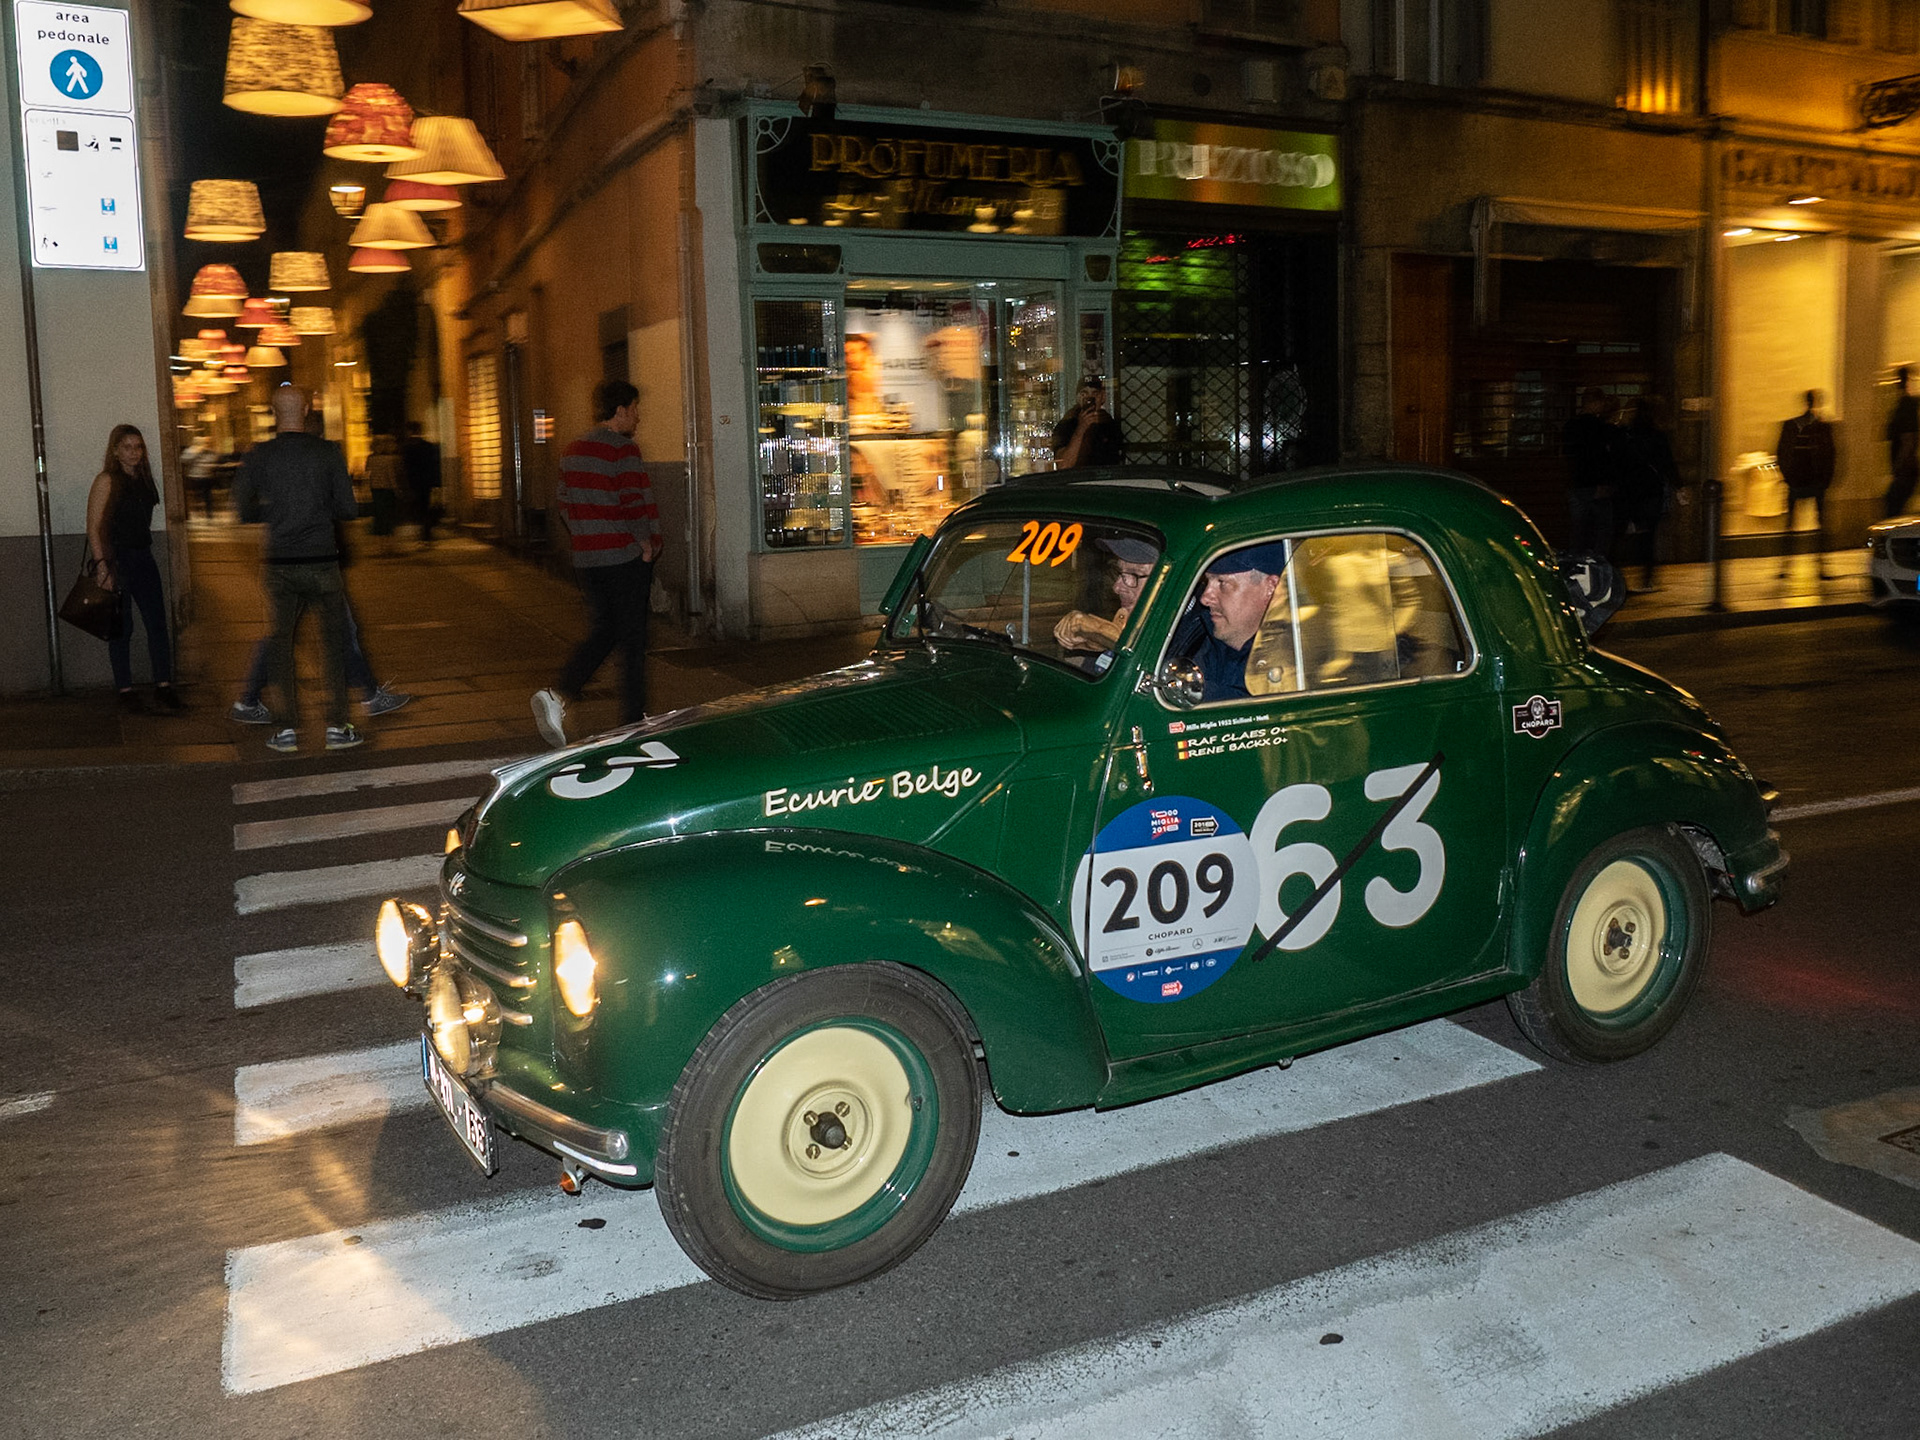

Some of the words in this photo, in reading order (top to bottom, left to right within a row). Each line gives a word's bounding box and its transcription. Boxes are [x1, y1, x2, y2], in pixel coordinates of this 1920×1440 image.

[55, 11, 90, 24] area
[37, 28, 110, 45] pedonale
[810, 133, 1086, 187] PROFUMERIA
[1006, 520, 1083, 567] 209
[1521, 719, 1554, 729] CHOPARD
[1187, 735, 1217, 747] RAF
[1221, 728, 1266, 743] CLAES
[1188, 745, 1225, 758] RENE
[1229, 738, 1271, 752] BACKX
[765, 777, 883, 817] Ecurie
[892, 765, 981, 798] Belge
[1151, 817, 1179, 826] MIGLIA
[1249, 762, 1446, 951] 63
[1101, 852, 1234, 934] 209
[1148, 927, 1193, 940] CHOPARD
